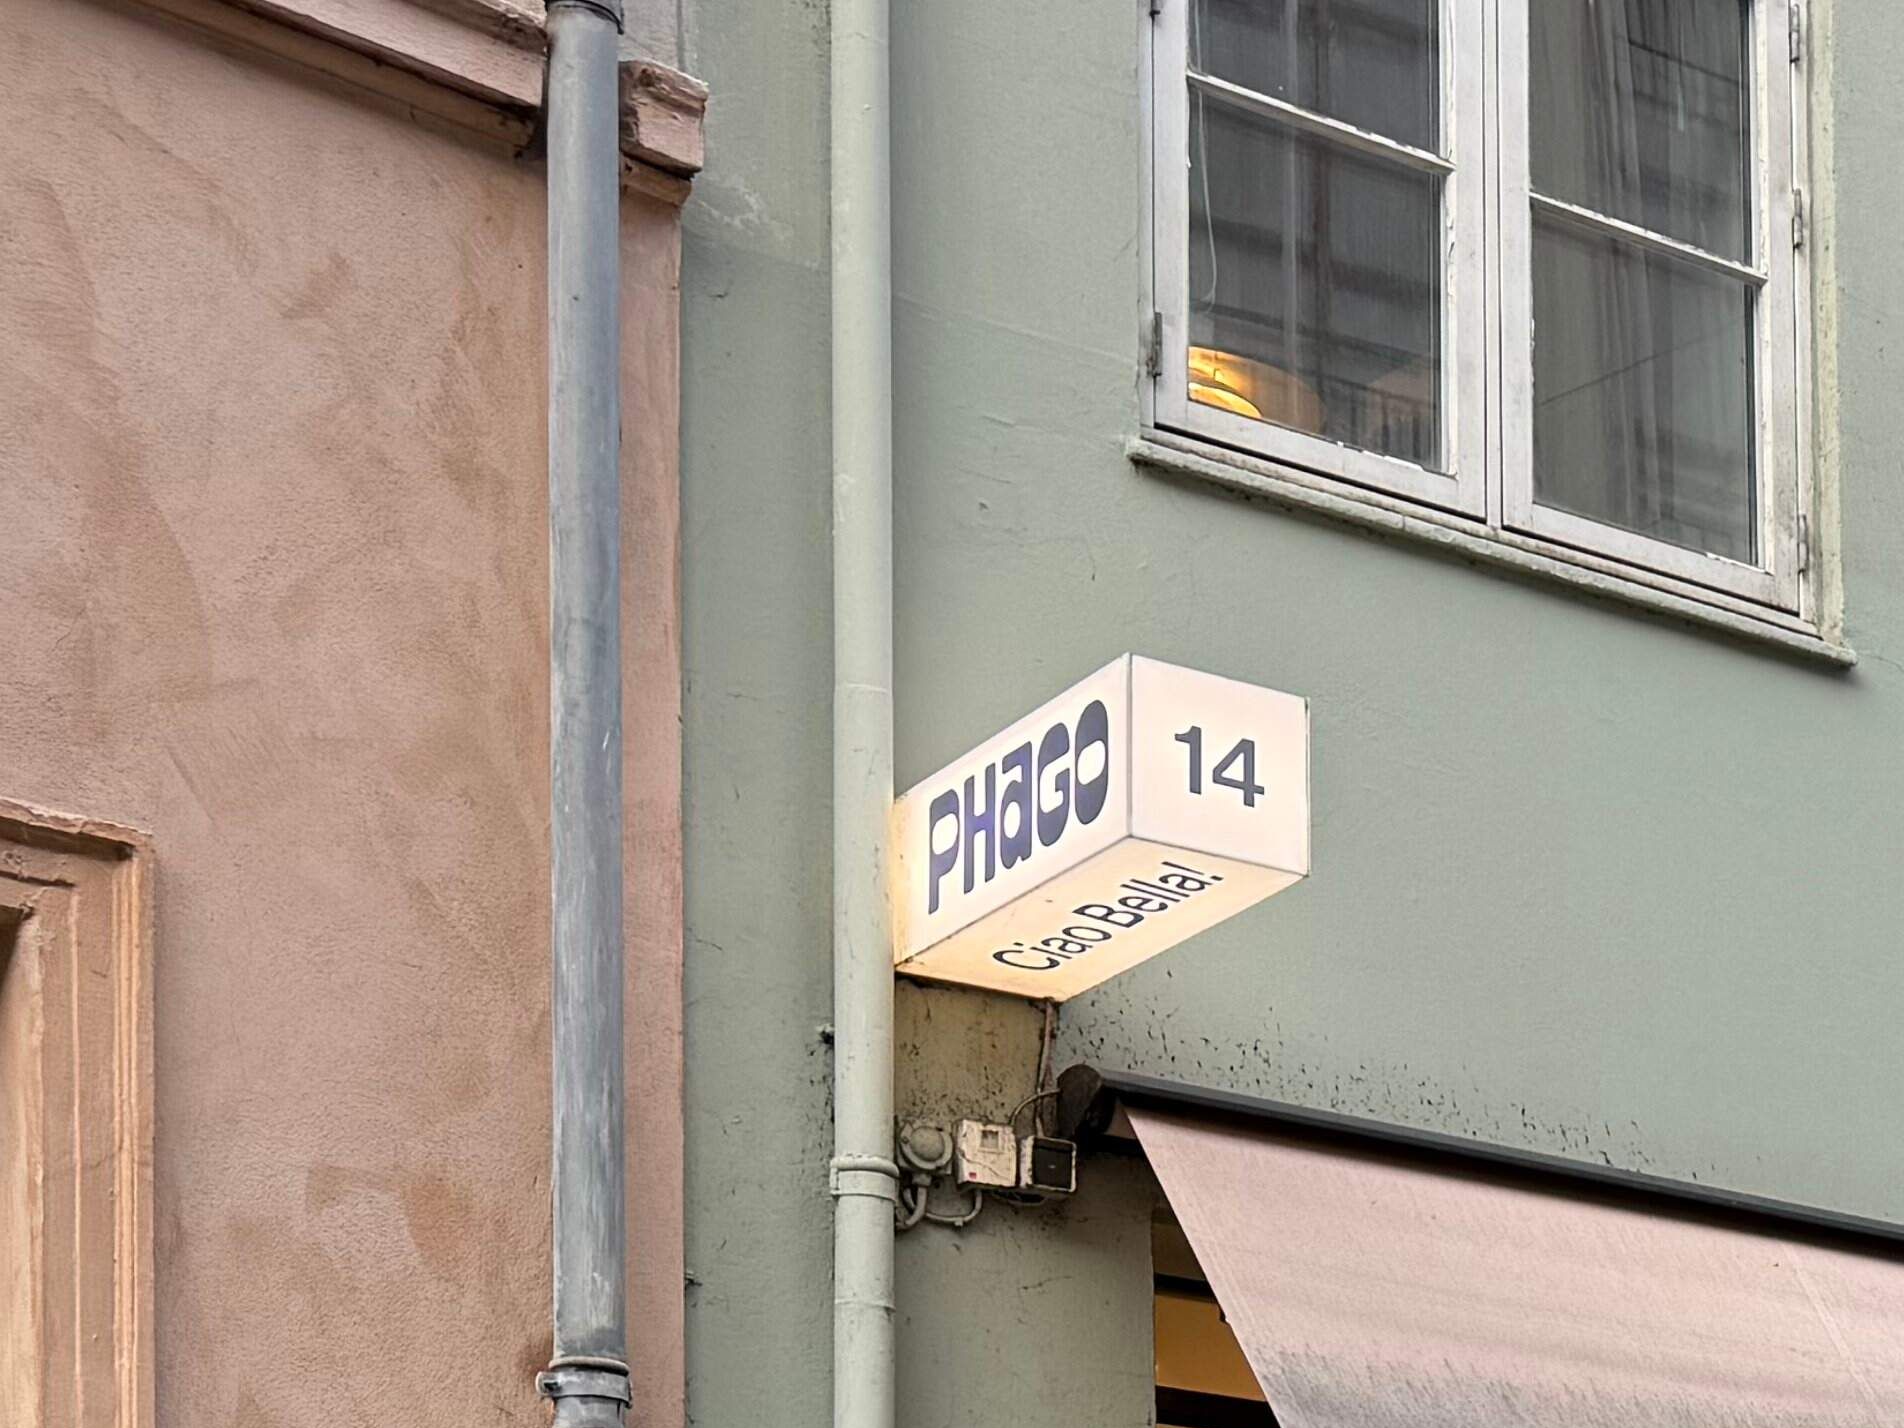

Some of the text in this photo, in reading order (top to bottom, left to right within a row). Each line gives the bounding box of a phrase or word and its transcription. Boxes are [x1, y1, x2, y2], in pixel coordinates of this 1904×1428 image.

[1174, 725, 1265, 808] 14
[991, 860, 1224, 972] Ciao Bella!
